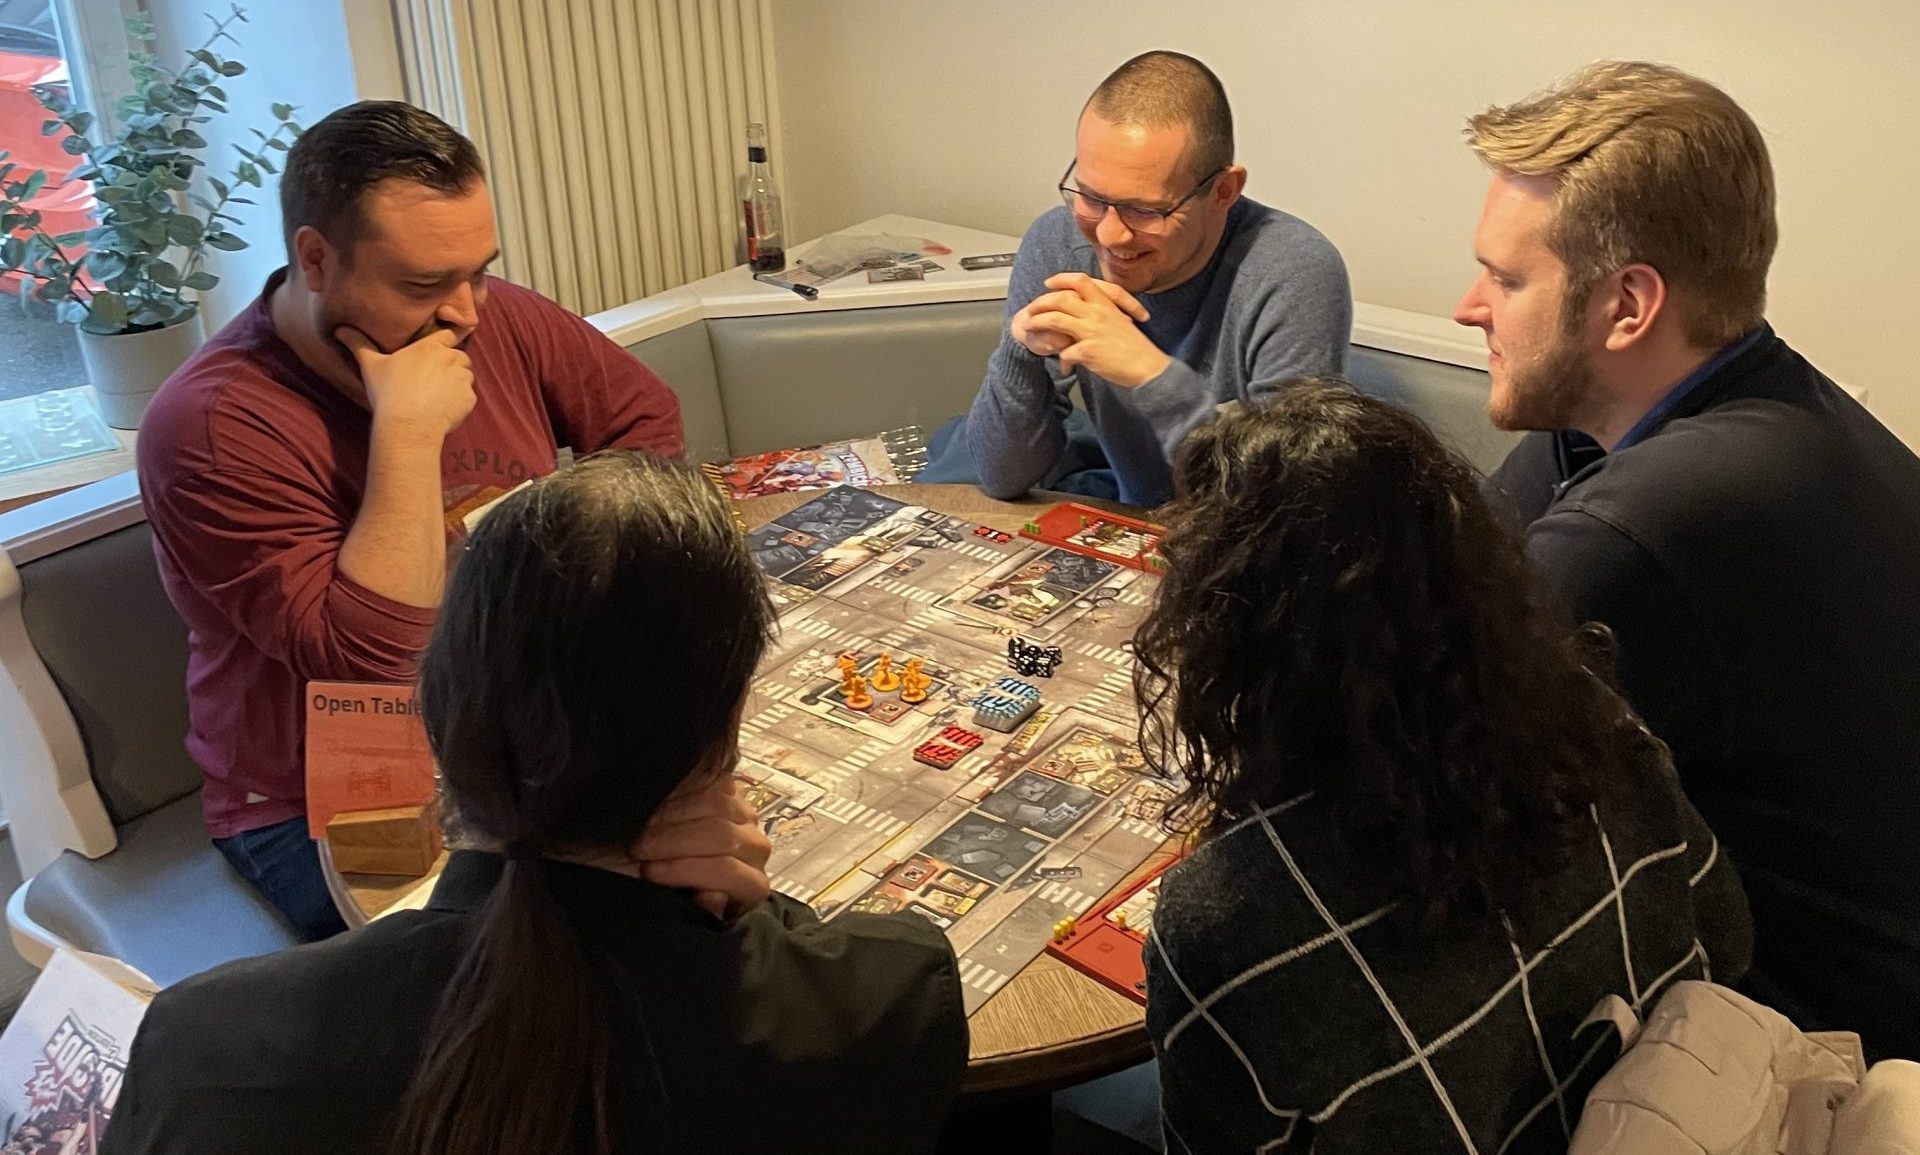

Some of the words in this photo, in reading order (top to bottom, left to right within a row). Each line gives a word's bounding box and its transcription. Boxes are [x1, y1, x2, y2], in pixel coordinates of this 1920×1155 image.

[443, 449, 539, 481] XPLO
[313, 694, 366, 716] Open
[371, 697, 423, 715] Table
